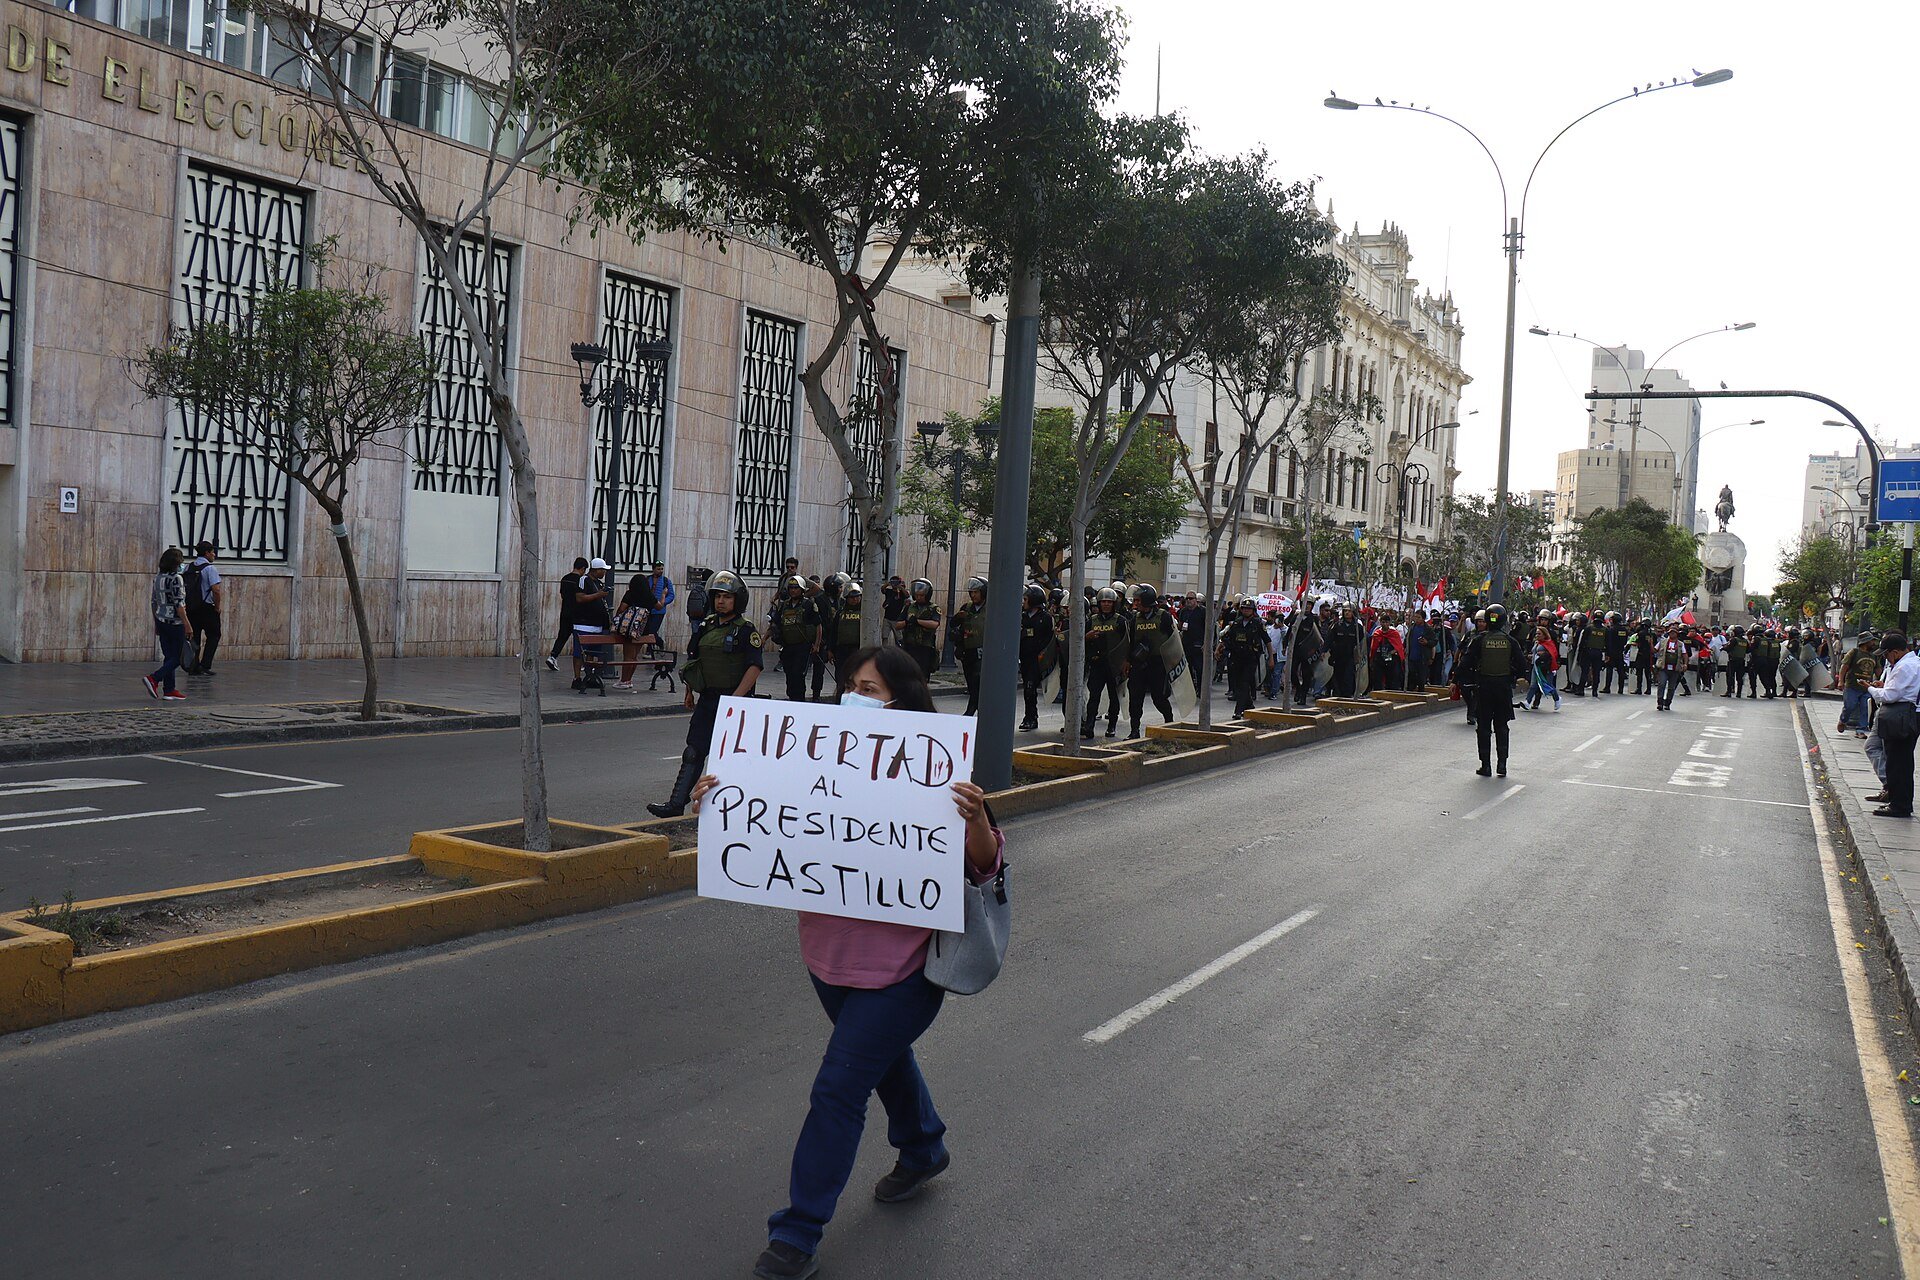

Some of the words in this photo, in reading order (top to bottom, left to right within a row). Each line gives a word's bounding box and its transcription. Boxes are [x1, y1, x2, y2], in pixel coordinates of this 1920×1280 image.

[7, 24, 72, 87] DE
[102, 55, 375, 175] ELECCIONES
[712, 785, 947, 854] PRESIDENTE
[810, 775, 842, 798] AL
[720, 842, 941, 911] CASTILLO
